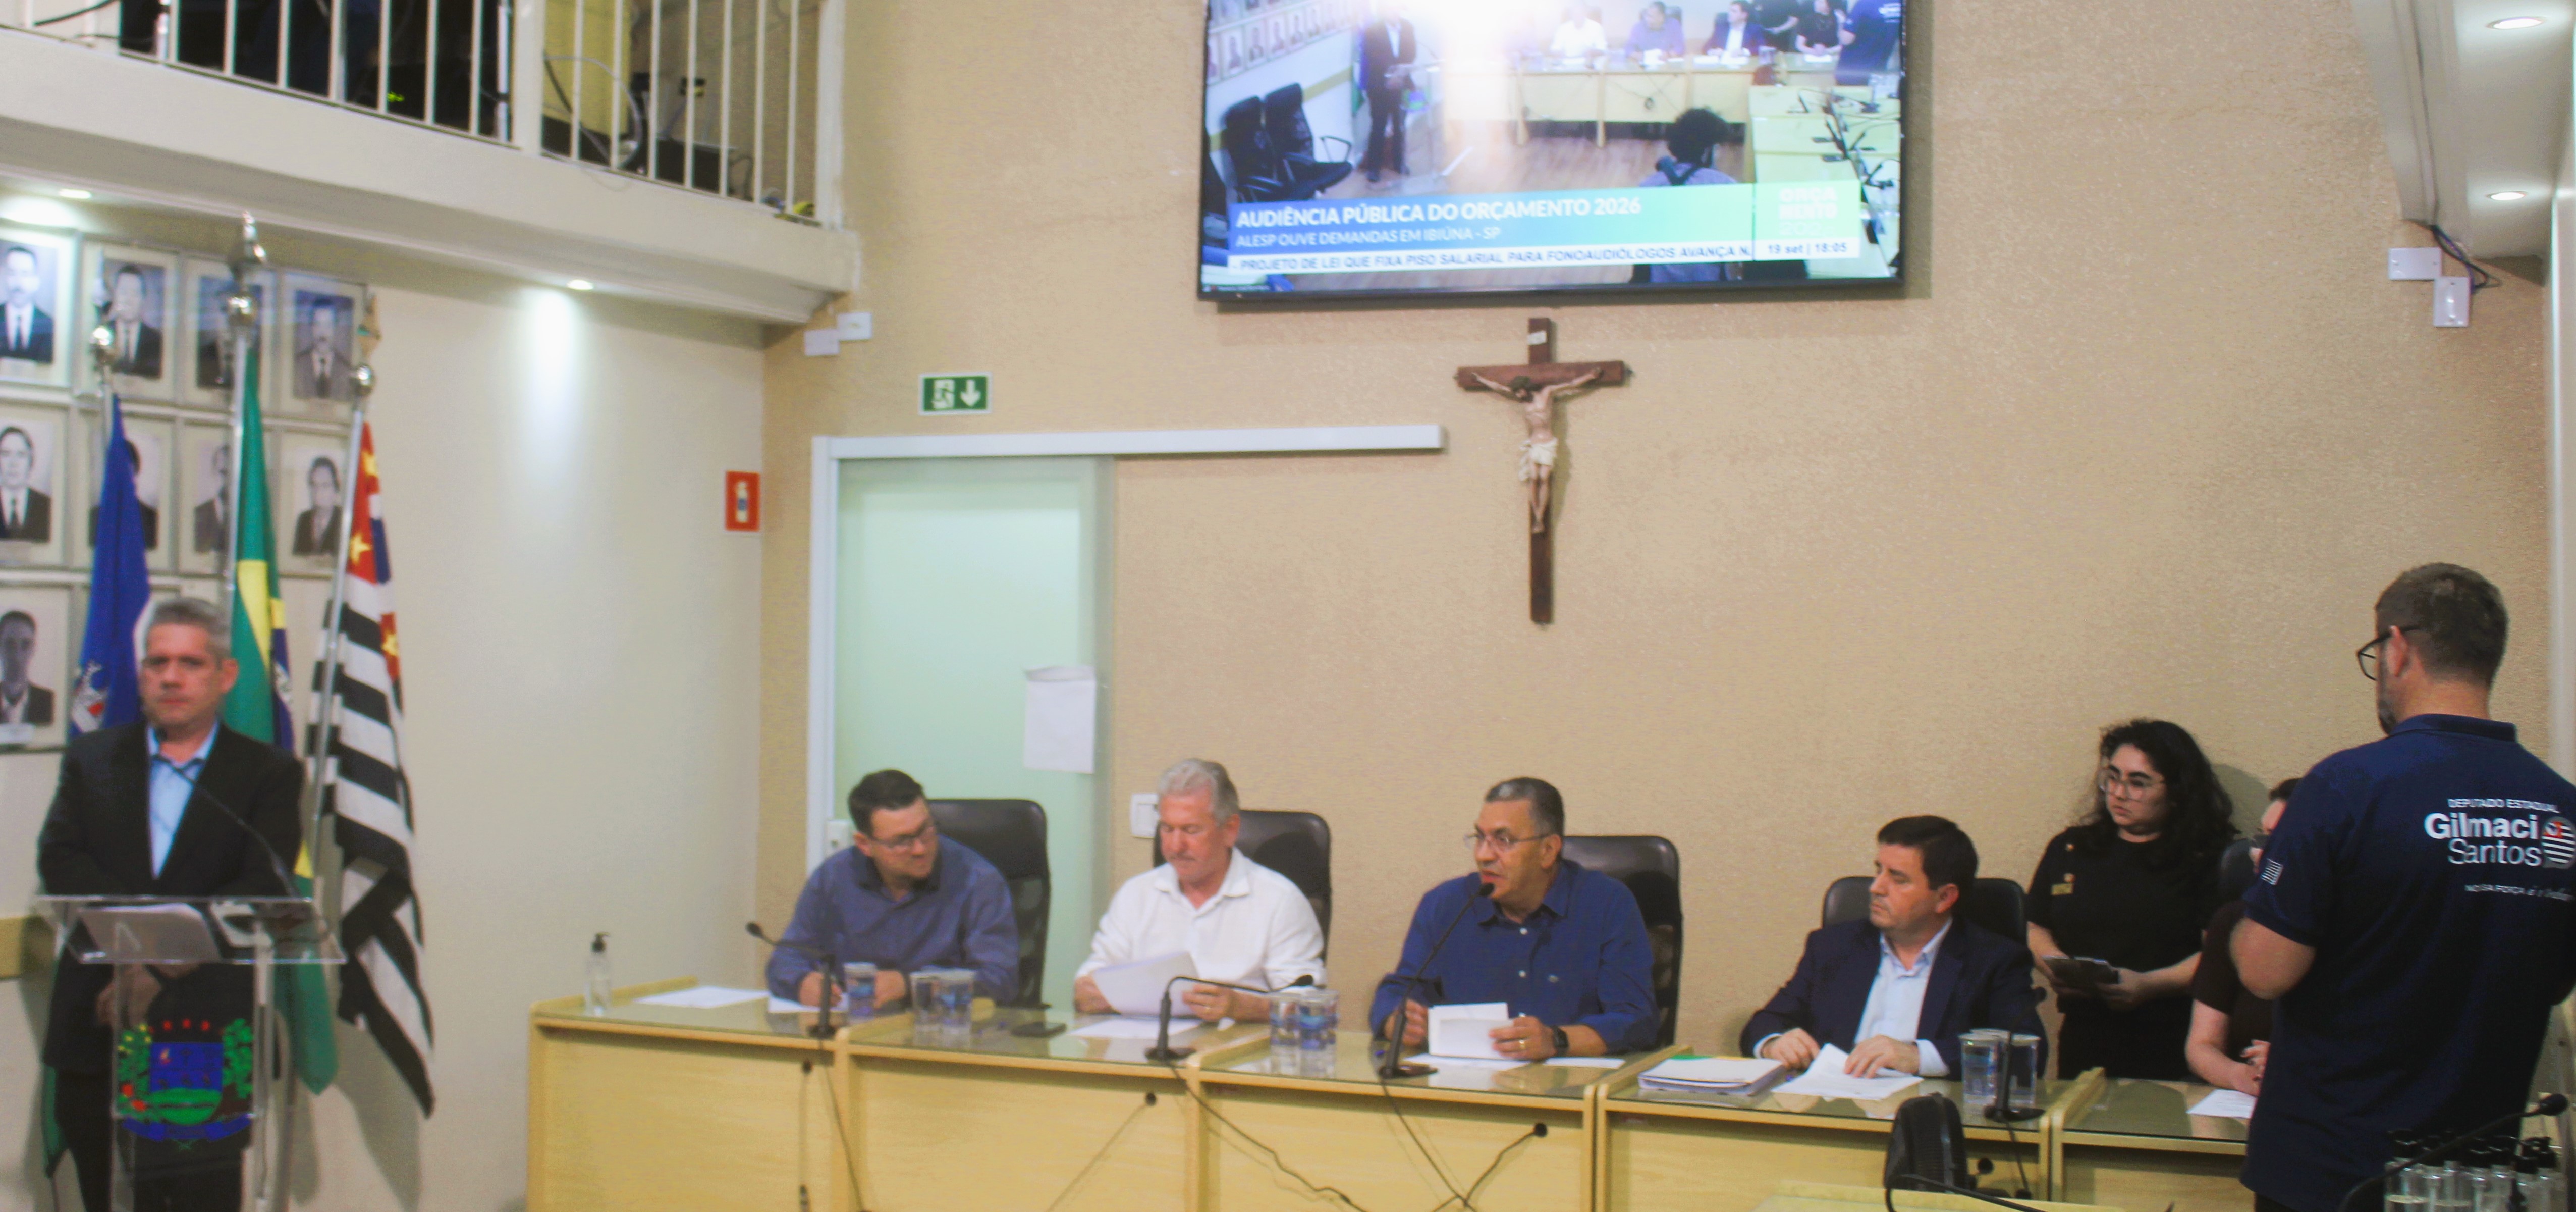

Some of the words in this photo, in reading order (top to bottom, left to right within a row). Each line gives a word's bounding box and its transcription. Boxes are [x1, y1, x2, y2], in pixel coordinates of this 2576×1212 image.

[1236, 206, 1340, 228] AUDIÊNCIA
[1343, 203, 1425, 224] PÚBLICA
[1428, 203, 1459, 221] DO
[1461, 199, 1591, 221] ORÇAMENTO
[1594, 197, 1642, 215] 2026
[1236, 234, 1277, 247] ALESP
[1278, 232, 1317, 246] OUVE
[1319, 230, 1397, 245] DEMANDAS
[1400, 229, 1421, 241] EM
[1424, 226, 1473, 241] IBIÚNA
[1483, 227, 1501, 240] SP
[1768, 244, 1780, 254] 19
[1785, 245, 1803, 254] set
[1815, 242, 1847, 253] 18:05
[1240, 257, 1298, 270] PROJETO
[1301, 257, 1317, 269] DE
[1322, 256, 1339, 268] LEI
[1344, 256, 1369, 268] QUE
[1375, 255, 1402, 266] FIXA
[1407, 254, 1436, 265] PISO
[1440, 252, 1503, 265] SALARIAL
[1508, 251, 1542, 262] PARA
[1547, 247, 1675, 261] FONOAUDIÓLOGOS
[1681, 246, 1735, 260] AVANÇA
[2448, 799, 2505, 808] DEPUTADO
[2506, 799, 2560, 813] ESTADUAL
[2424, 812, 2539, 839] Gilmaci
[2448, 838, 2543, 866] Santos
